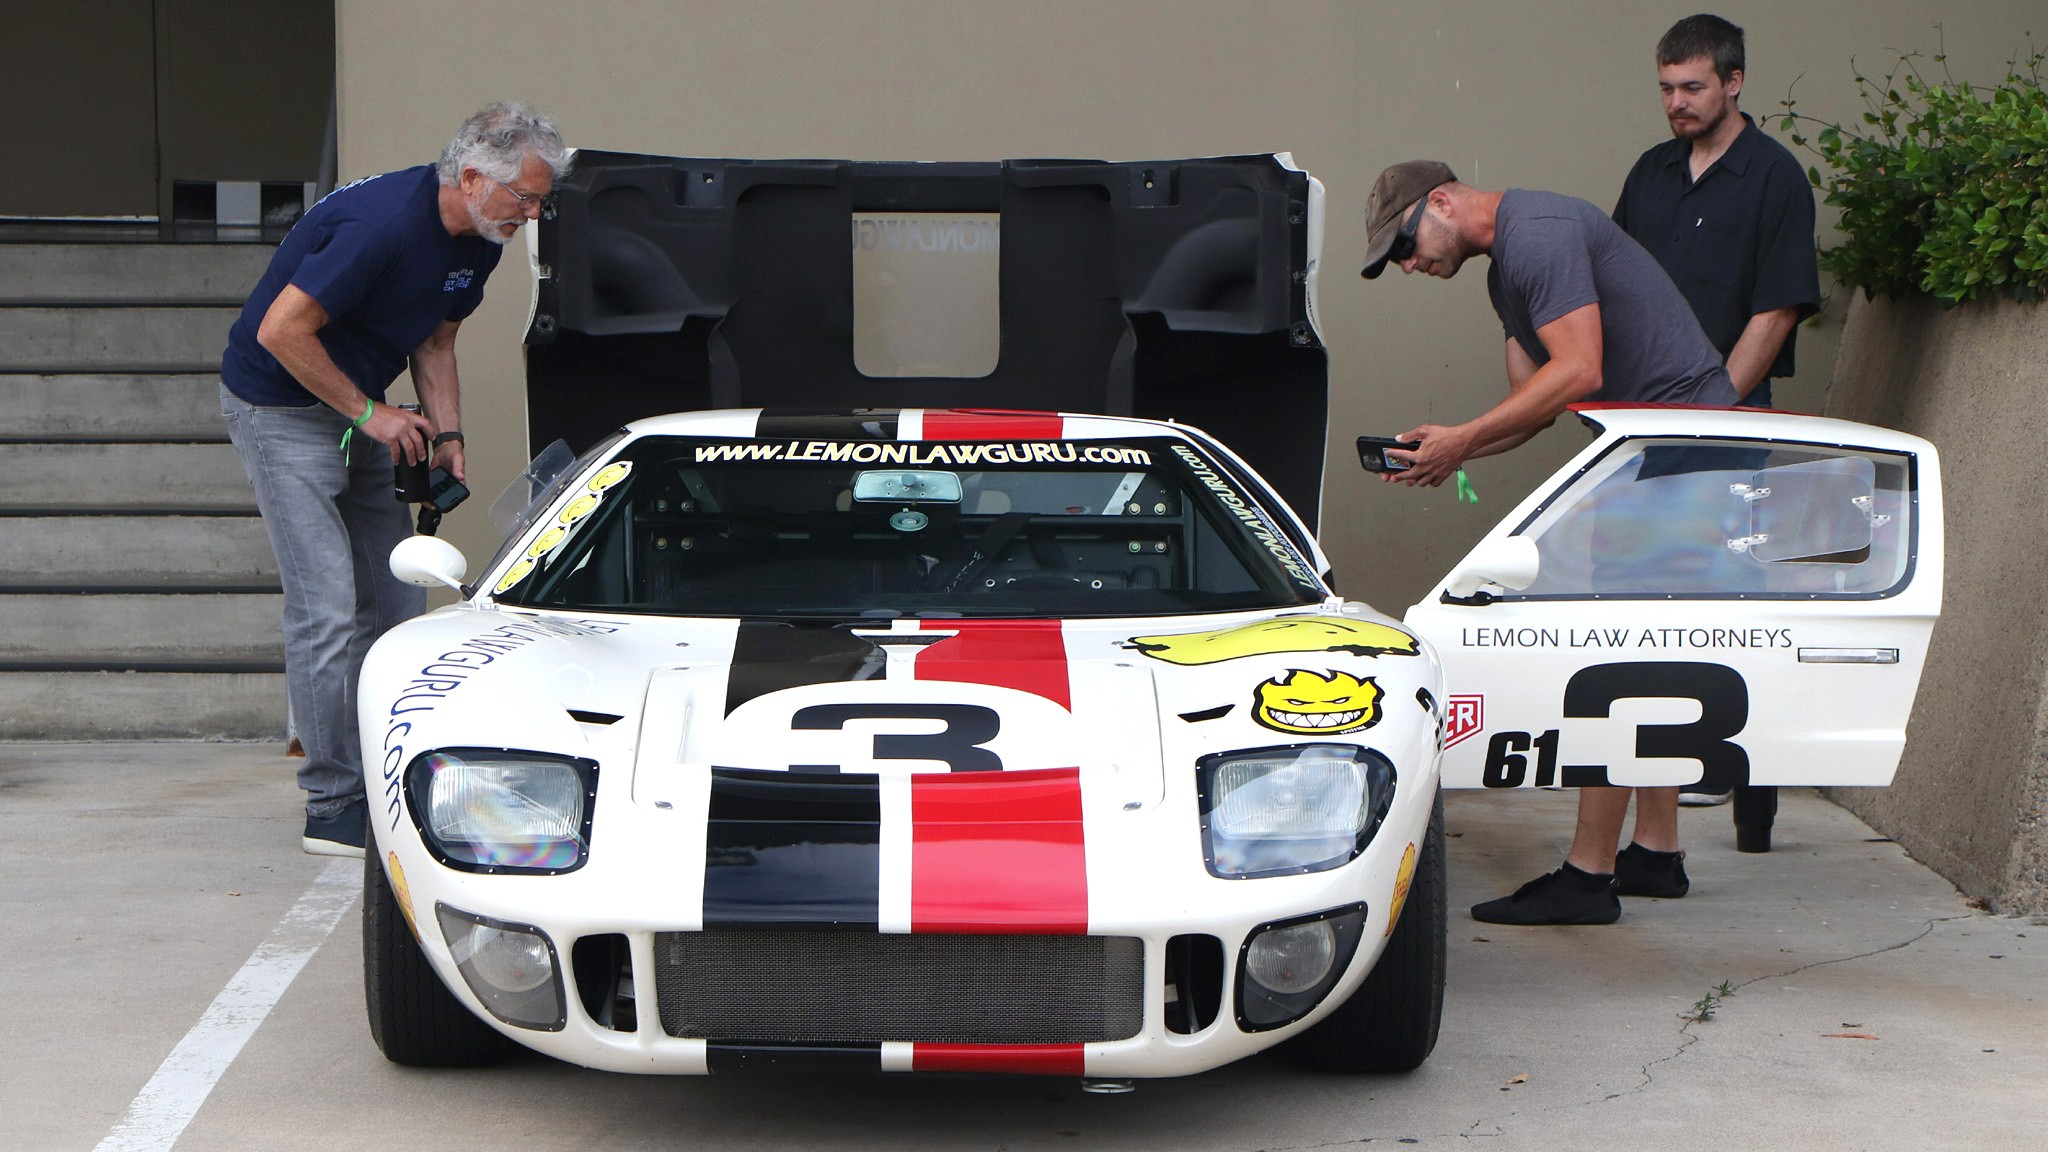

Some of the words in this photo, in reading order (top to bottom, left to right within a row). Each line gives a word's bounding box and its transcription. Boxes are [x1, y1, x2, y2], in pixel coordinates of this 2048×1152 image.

[695, 441, 1152, 466] www.LEMONLAWGURU.com
[1170, 445, 1318, 591] LEMONLAWGURU.com
[1462, 628, 1559, 647] LEMON
[1570, 628, 1630, 647] LAW
[1637, 628, 1793, 648] ATTORNEYS
[788, 703, 1003, 773] 3
[1561, 661, 1750, 788] 3
[1482, 729, 1560, 788] 61
